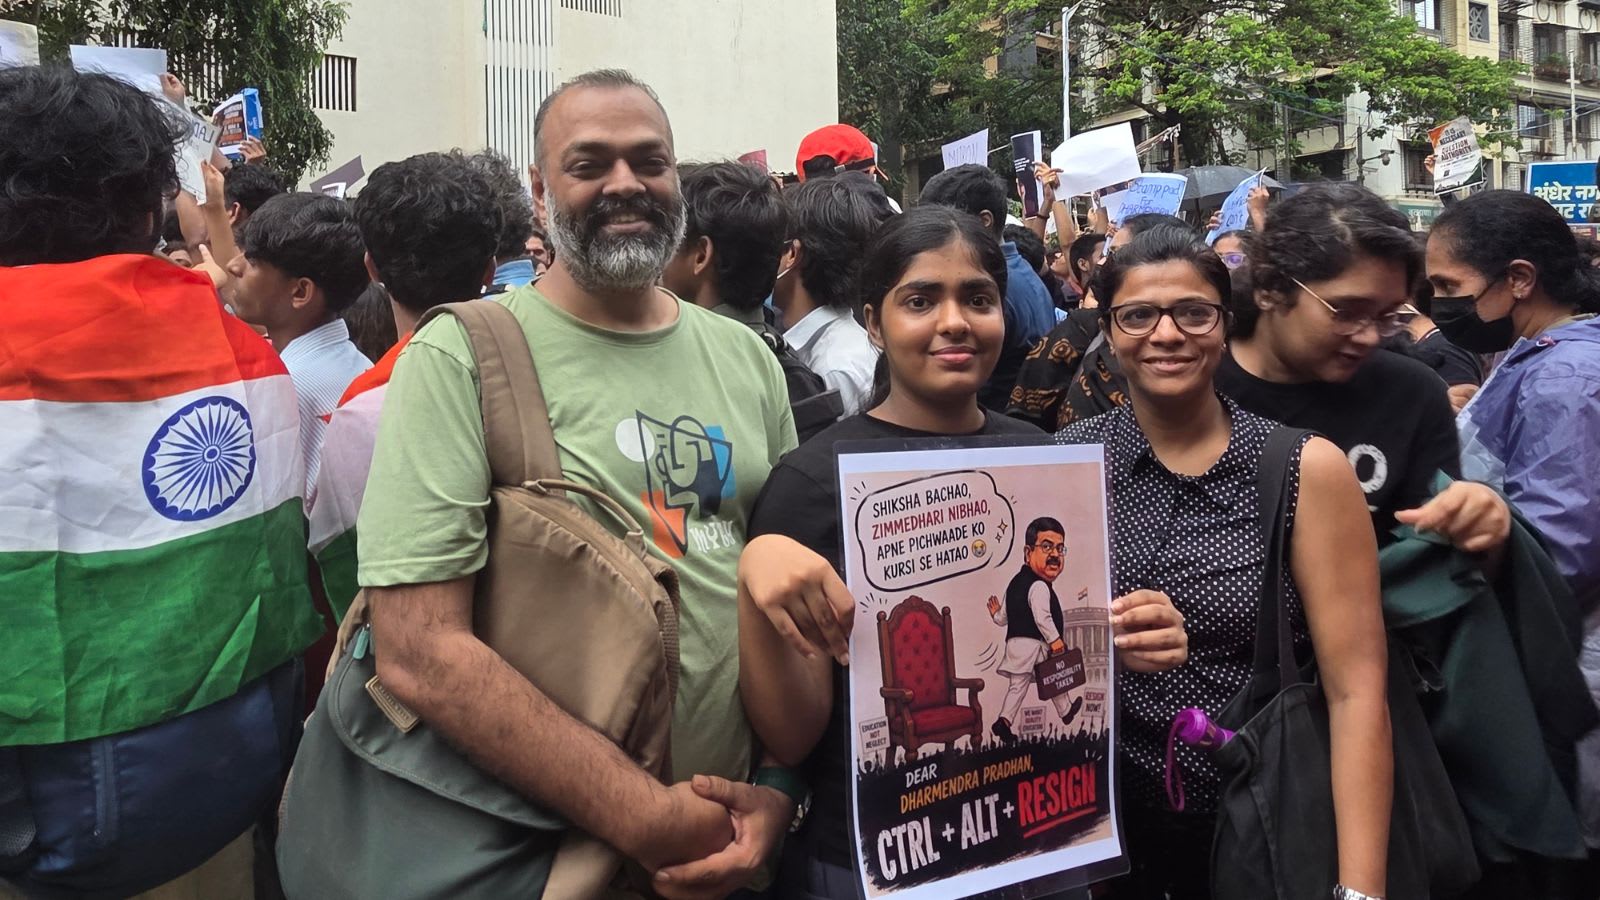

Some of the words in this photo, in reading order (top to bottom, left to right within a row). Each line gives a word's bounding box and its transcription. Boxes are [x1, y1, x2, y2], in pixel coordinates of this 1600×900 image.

[1440, 130, 1466, 145] NECESSARY
[1441, 139, 1469, 153] QUESTION
[1441, 146, 1472, 161] AUTHORITY
[1575, 185, 1600, 201] नग
[873, 493, 921, 518] SHIKSHA
[926, 483, 971, 505] BACHAO,
[872, 509, 944, 540] ZIMMEDHARI
[949, 499, 991, 521] NIBHAO,
[877, 541, 905, 561] APNE
[909, 525, 968, 552] PICHWAADE
[972, 521, 985, 537] KO
[883, 561, 915, 581] KURSI
[920, 556, 932, 571] SE
[936, 546, 968, 567] HATAO
[1055, 660, 1065, 671] NO
[1042, 663, 1082, 686] RESPONSIBILITY
[1055, 676, 1074, 689] TAKEN
[861, 720, 887, 733] EDUCATION
[870, 730, 880, 739] NOT
[865, 737, 887, 749] NEGLECT
[900, 770, 980, 814] DHARMENDRA
[983, 753, 1034, 785] PRADHAN,
[905, 763, 938, 788] DEAR
[877, 816, 941, 881] CTRL
[942, 823, 955, 842] +
[960, 793, 1000, 850] ALT
[1003, 802, 1015, 819] +
[1017, 761, 1097, 827] RESIGN
